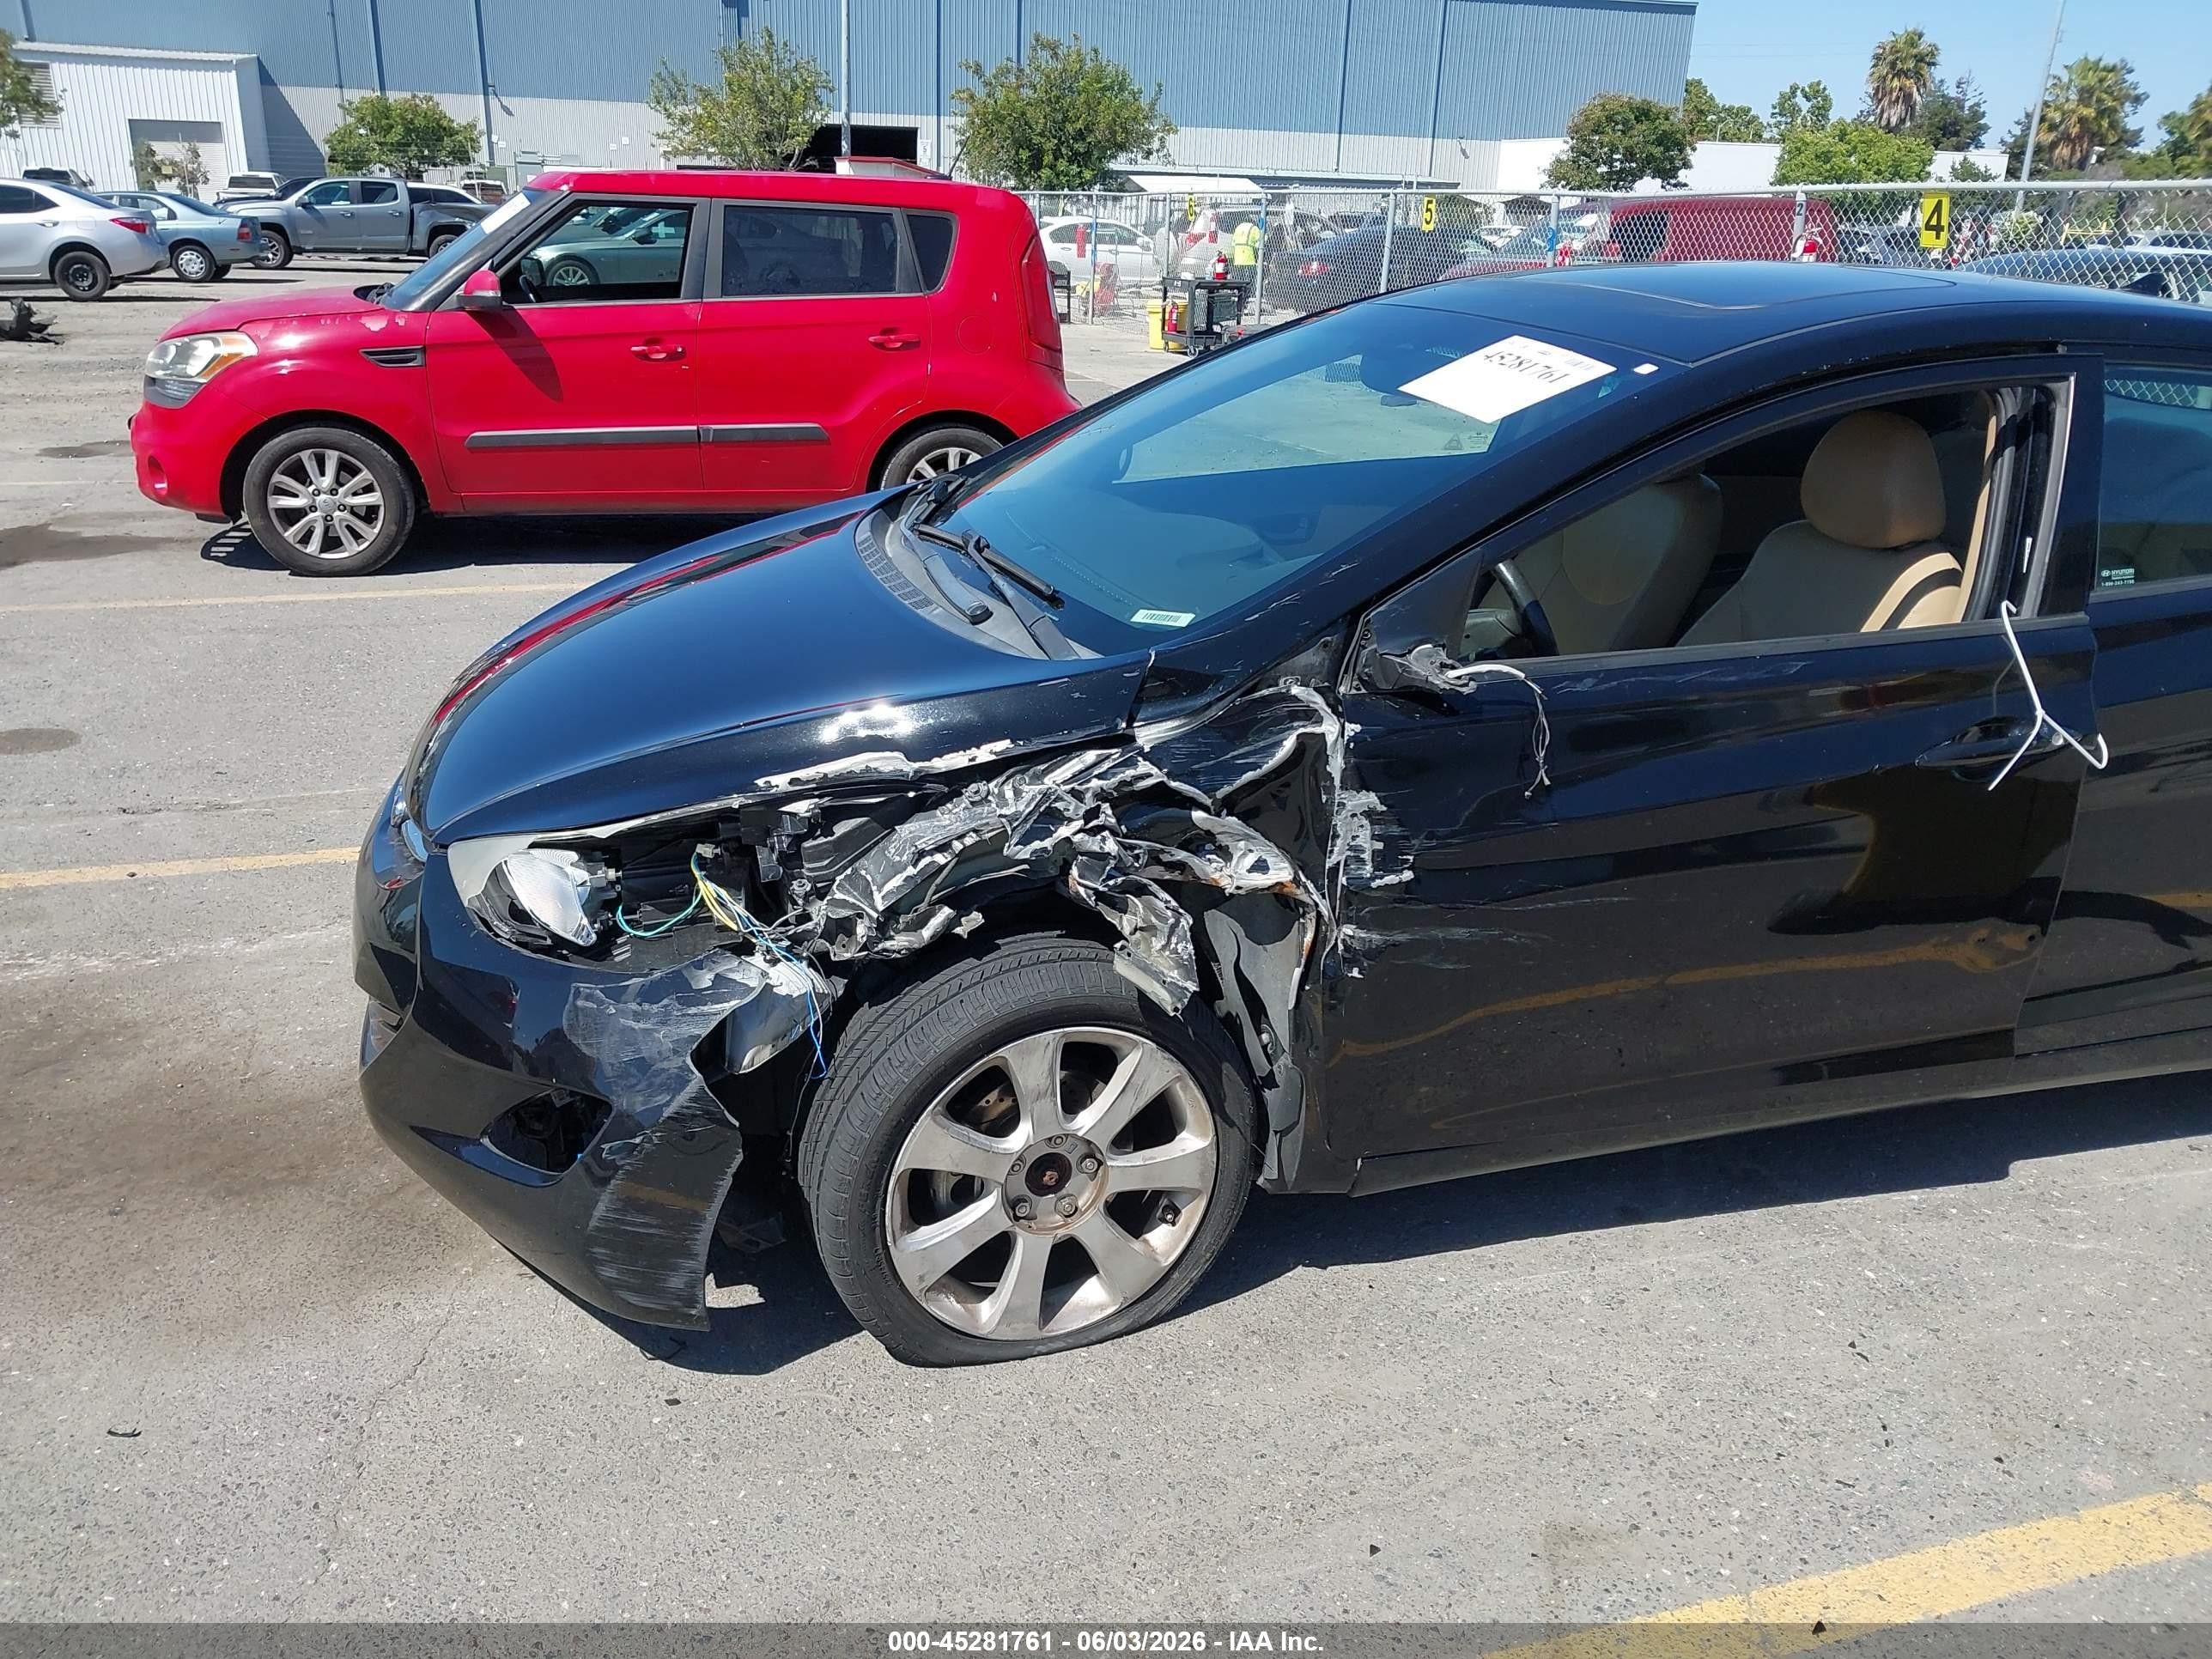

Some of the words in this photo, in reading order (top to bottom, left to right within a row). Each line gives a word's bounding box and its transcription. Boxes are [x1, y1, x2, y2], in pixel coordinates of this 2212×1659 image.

[1188, 198, 1194, 216] 6
[1425, 199, 1432, 225] 5
[1796, 203, 1803, 216] 2
[1924, 199, 1945, 240] 4
[1483, 351, 1571, 383] 45281761
